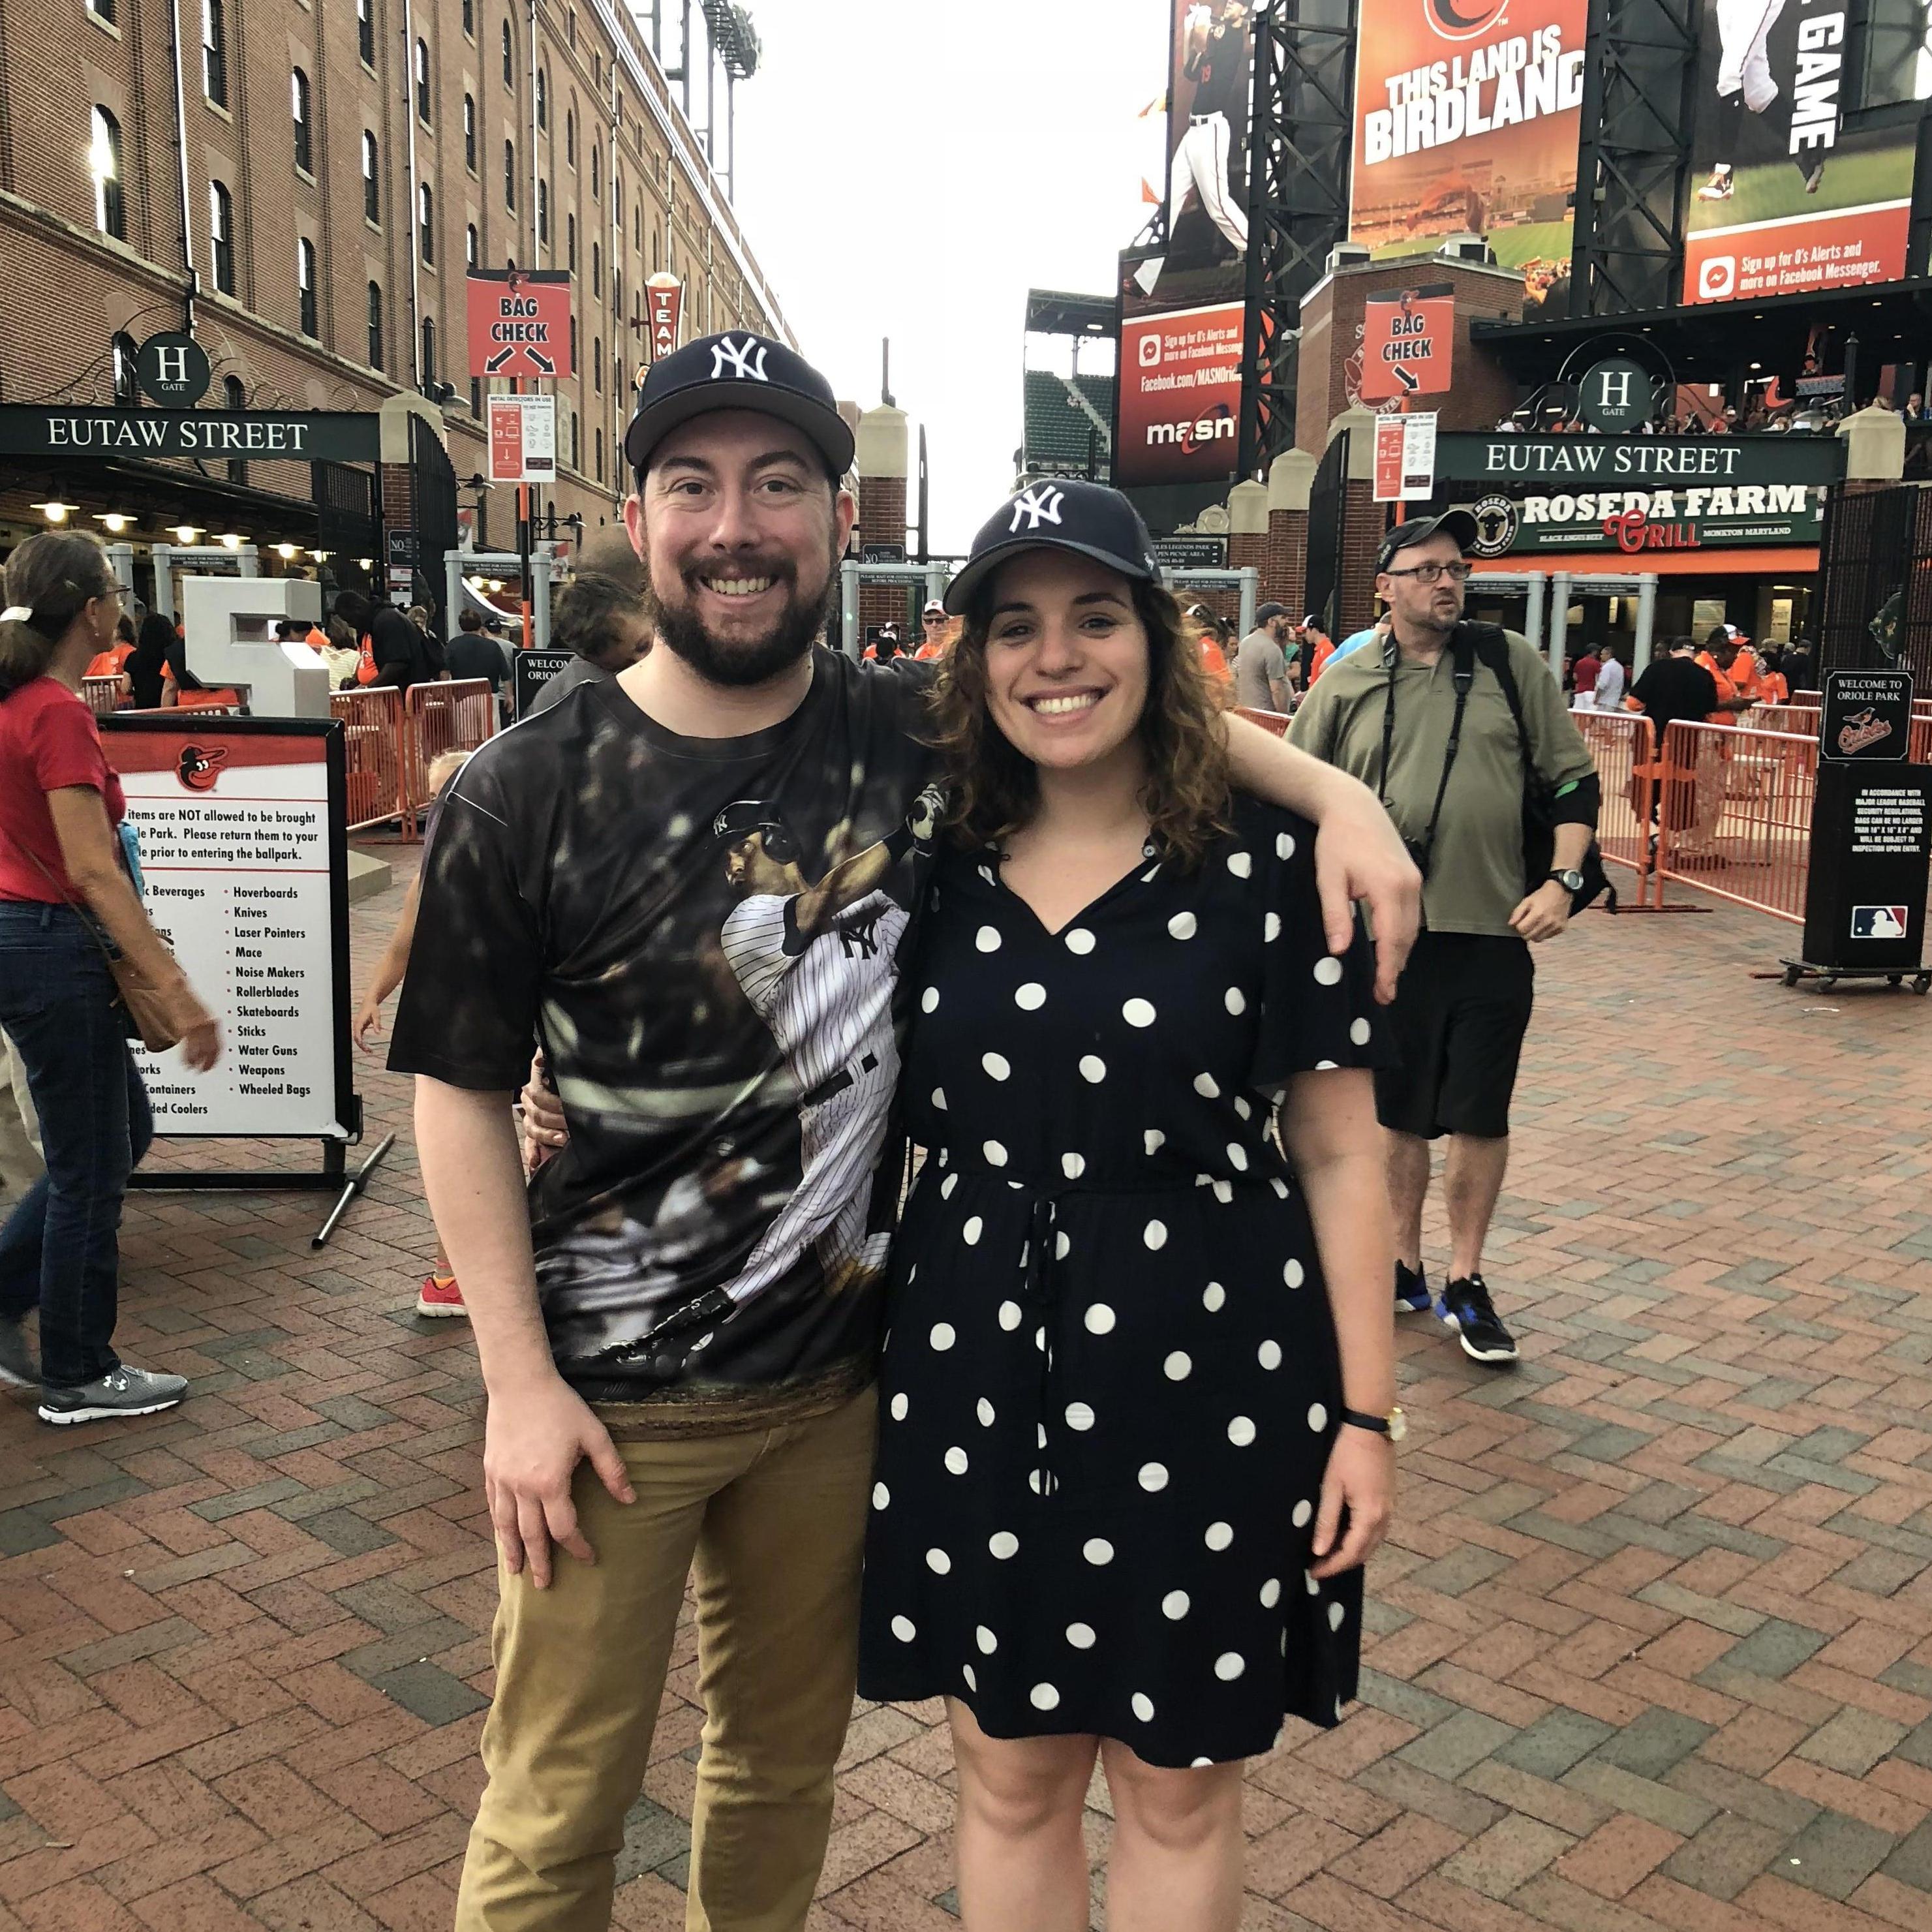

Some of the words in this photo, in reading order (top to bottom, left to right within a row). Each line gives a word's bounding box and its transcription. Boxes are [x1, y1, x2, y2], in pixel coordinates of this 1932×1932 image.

[1385, 60, 1447, 109] THIS
[1452, 36, 1527, 89] LAND
[1533, 23, 1561, 65] IS
[1789, 12, 1845, 155] GAME
[1365, 50, 1586, 166] BIRDLAND
[1741, 256, 1762, 274] Sign
[1764, 256, 1776, 271] up
[1779, 251, 1792, 267] for
[1811, 245, 1841, 262] Alerts
[1843, 240, 1862, 258] and
[1740, 277, 1764, 291] more
[1766, 274, 1778, 287] on
[1780, 265, 1823, 285] Facebook
[1825, 260, 1881, 279] Messenger.
[500, 297, 538, 318] BAG
[490, 322, 549, 343] CHECK
[1391, 314, 1425, 337] BAG
[1164, 335, 1177, 349] Sign
[1178, 335, 1186, 347] up
[1187, 332, 1197, 345] for
[1206, 328, 1225, 342] Alerts
[1226, 326, 1238, 339] and
[711, 335, 769, 382] NY
[1164, 350, 1178, 362] more
[1180, 348, 1188, 360] on
[1188, 345, 1214, 359] Facebook
[1216, 342, 1243, 356] Messeng
[1382, 337, 1434, 362] CHECK
[153, 346, 191, 382] H
[1597, 371, 1633, 406] H
[1602, 408, 1625, 416] GATE
[46, 418, 169, 447] EUTAW
[179, 421, 308, 450] STREET
[1146, 416, 1235, 445] masn
[1485, 444, 1606, 472] EUTAW
[1614, 446, 1741, 474] STREET
[1009, 485, 1065, 533] NY
[1522, 489, 1676, 523] ROSEDA
[1684, 485, 1807, 517] FARM
[1602, 508, 1701, 553] GRILL
[1702, 529, 1743, 537] MONKTON
[1745, 527, 1792, 536] MARYLAND
[1838, 679, 1887, 689] WELCOME
[1890, 680, 1903, 689] TO
[1837, 692, 1873, 701] ORIOLE
[1875, 692, 1900, 701] PARK
[128, 808, 155, 820] items
[178, 809, 201, 821] NOT
[204, 810, 244, 821] allowed
[247, 812, 258, 822] to
[261, 810, 273, 822] be
[276, 810, 316, 826] brought
[150, 827, 177, 839] Park.
[184, 828, 217, 839] Please
[220, 831, 251, 840] return
[254, 829, 279, 840] them
[283, 831, 292, 841] to
[296, 833, 318, 844] your
[151, 846, 176, 860] prior
[178, 848, 188, 857] to
[191, 848, 234, 861] entering
[236, 847, 253, 859] the
[256, 847, 301, 862] ballpark.
[153, 885, 206, 900] Beverages
[234, 886, 298, 898] Hoverboards
[234, 906, 268, 917] Knives
[235, 927, 261, 938] Laser
[264, 927, 305, 938] Pointers
[236, 947, 262, 957] Mace
[236, 966, 264, 977] Noise
[268, 966, 305, 977] Makers
[236, 986, 299, 998] Rollerblades
[237, 1005, 299, 1017] Skateboards
[238, 1025, 266, 1037] Sticks
[238, 1045, 269, 1056] Water
[272, 1045, 298, 1056] Guns
[139, 1064, 161, 1074] orks
[239, 1064, 285, 1078] Weapons
[239, 1083, 283, 1094] Wheeled
[286, 1084, 311, 1097] Bags
[151, 1103, 167, 1113] ded
[171, 1103, 208, 1114] Coolers
